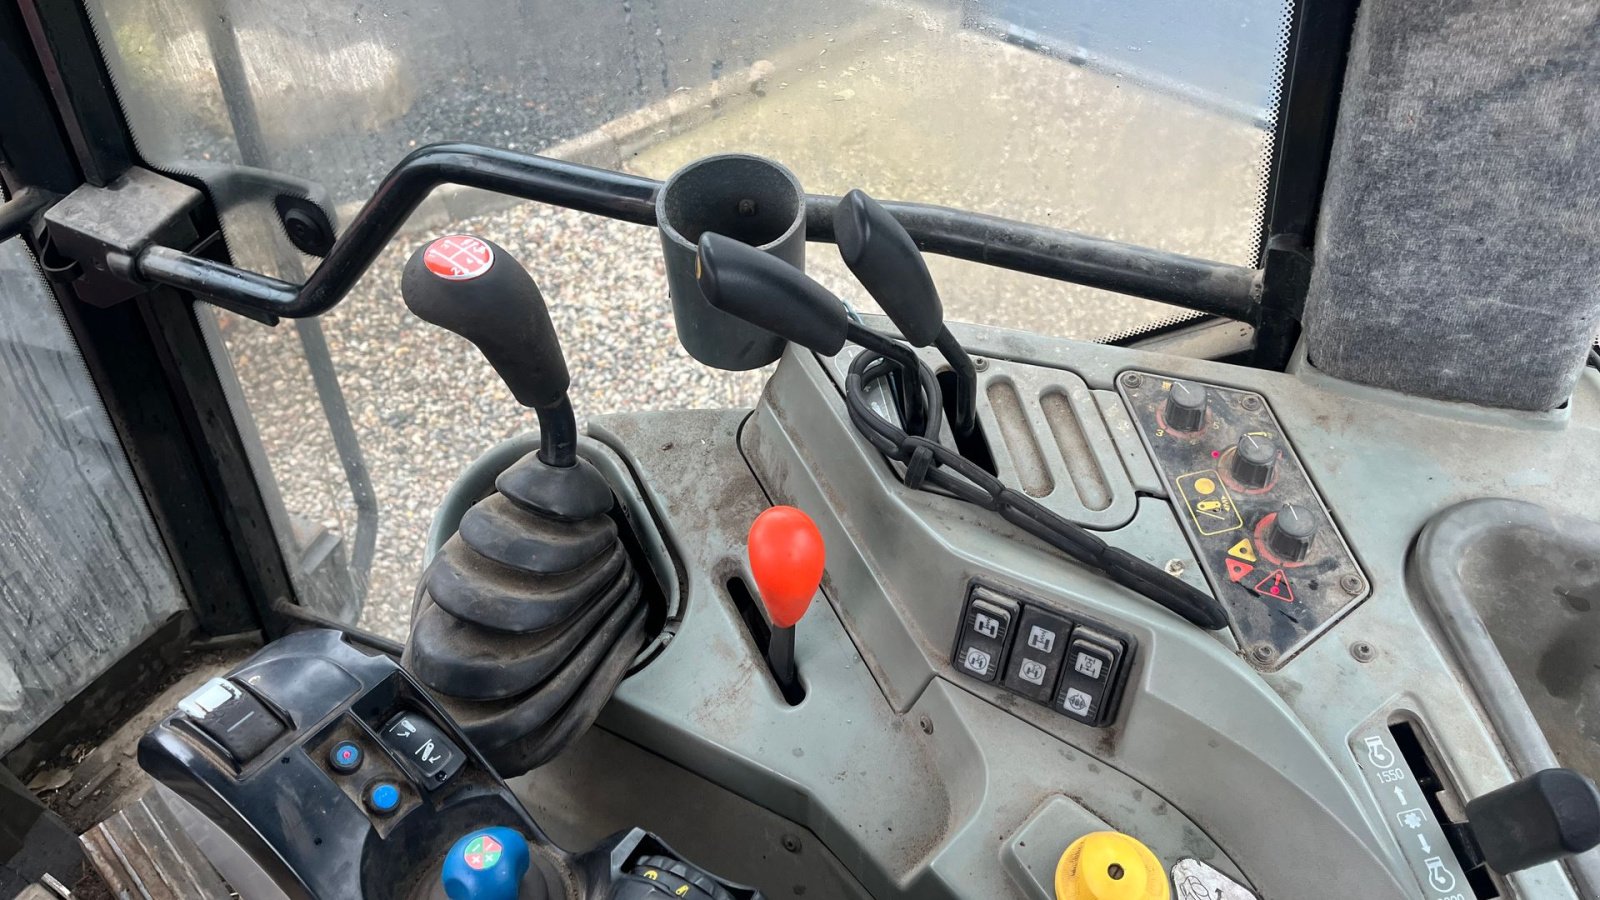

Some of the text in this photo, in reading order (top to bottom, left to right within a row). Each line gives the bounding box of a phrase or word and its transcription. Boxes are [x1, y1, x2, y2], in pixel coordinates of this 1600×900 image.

[1213, 421, 1220, 430] 5
[1155, 429, 1165, 437] 3
[1376, 768, 1405, 784] 1550
